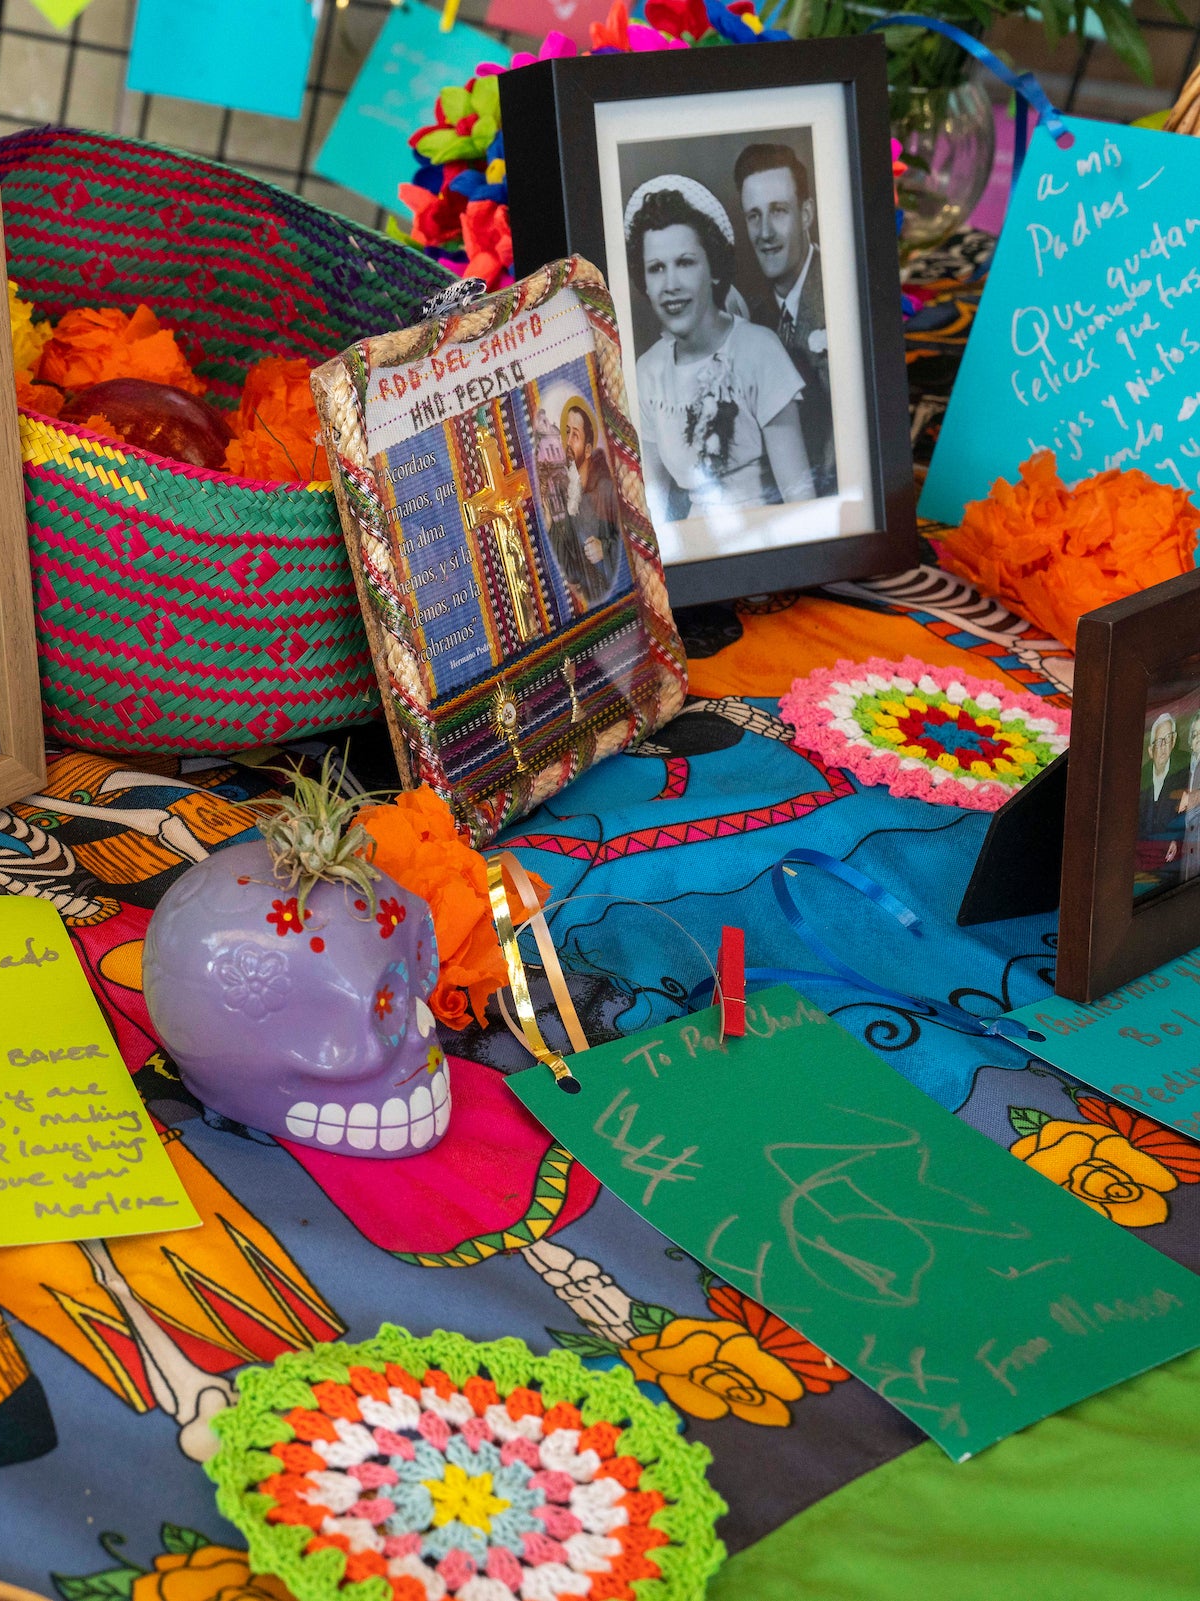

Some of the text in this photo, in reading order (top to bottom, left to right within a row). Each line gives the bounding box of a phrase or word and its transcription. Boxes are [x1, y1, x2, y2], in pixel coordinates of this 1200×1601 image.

[431, 348, 471, 382] DEL
[479, 312, 543, 364] SANTO
[1011, 301, 1097, 366] Que
[454, 359, 525, 410] PEDRO
[385, 480, 457, 524] rmanos, que
[399, 524, 446, 556] un alma
[397, 567, 438, 595] nemos,
[449, 550, 460, 571] si
[460, 546, 473, 565] la
[410, 580, 482, 629] demos, no la
[450, 651, 476, 669] Hermano
[7, 1044, 109, 1067] BAKER
[622, 1039, 672, 1078] To
[47, 1083, 107, 1098] are
[40, 1104, 142, 1132] making
[19, 1130, 146, 1163] laughing
[63, 1167, 130, 1188] you
